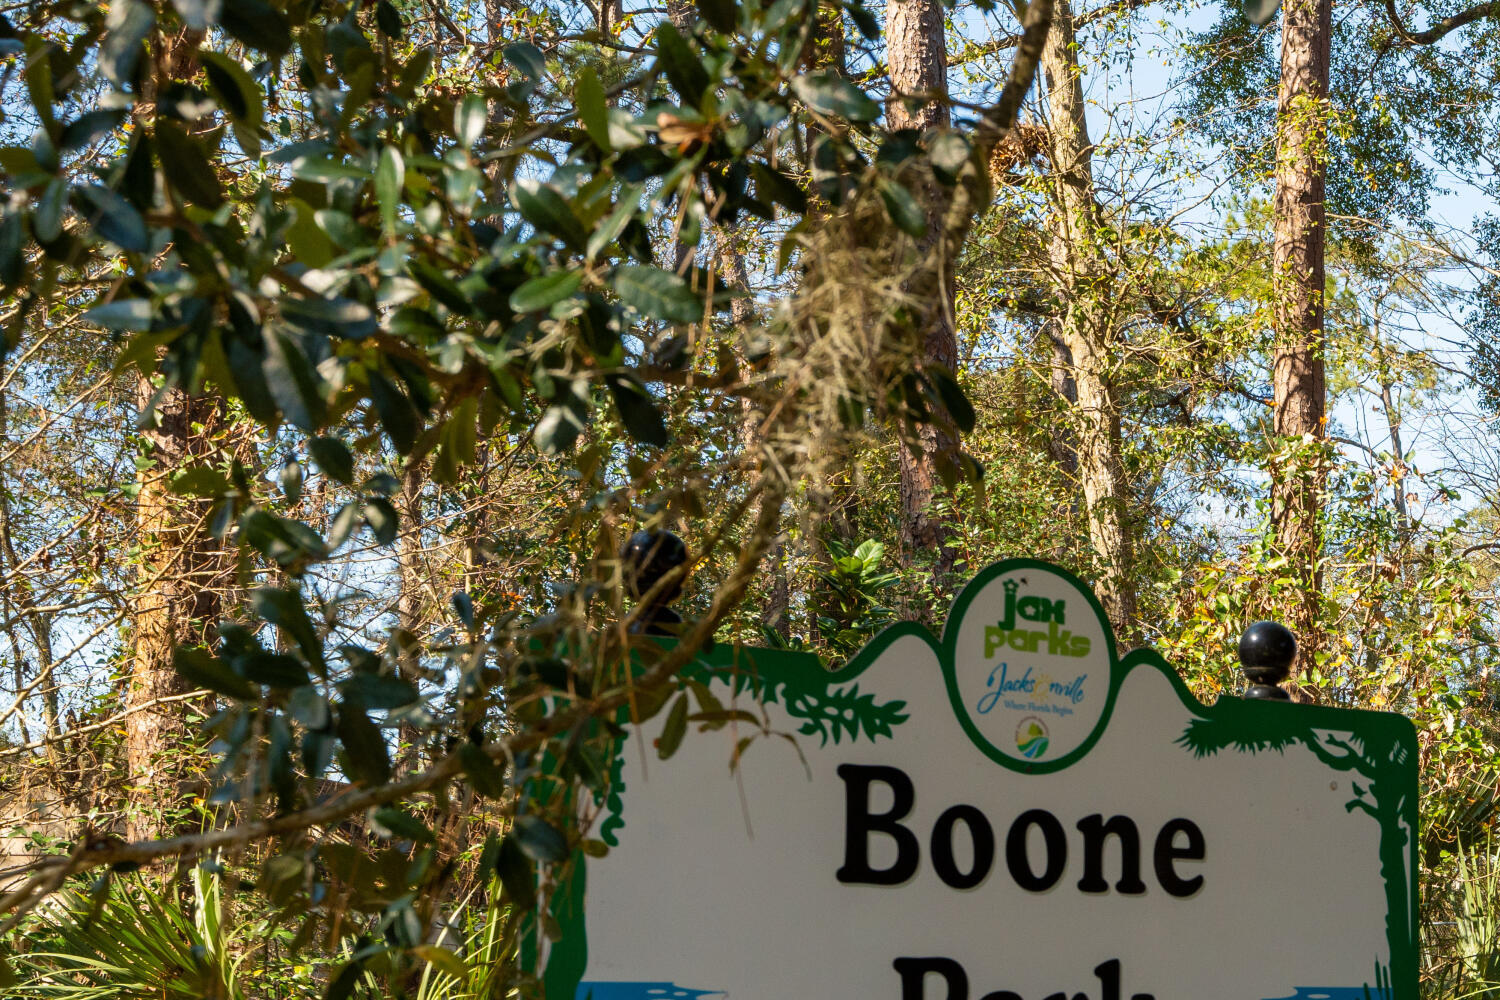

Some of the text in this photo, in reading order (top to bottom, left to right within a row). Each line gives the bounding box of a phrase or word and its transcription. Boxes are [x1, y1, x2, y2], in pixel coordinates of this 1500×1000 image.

[998, 578, 1066, 631] jax
[984, 621, 1092, 659] parks
[836, 763, 1206, 898] Boone
